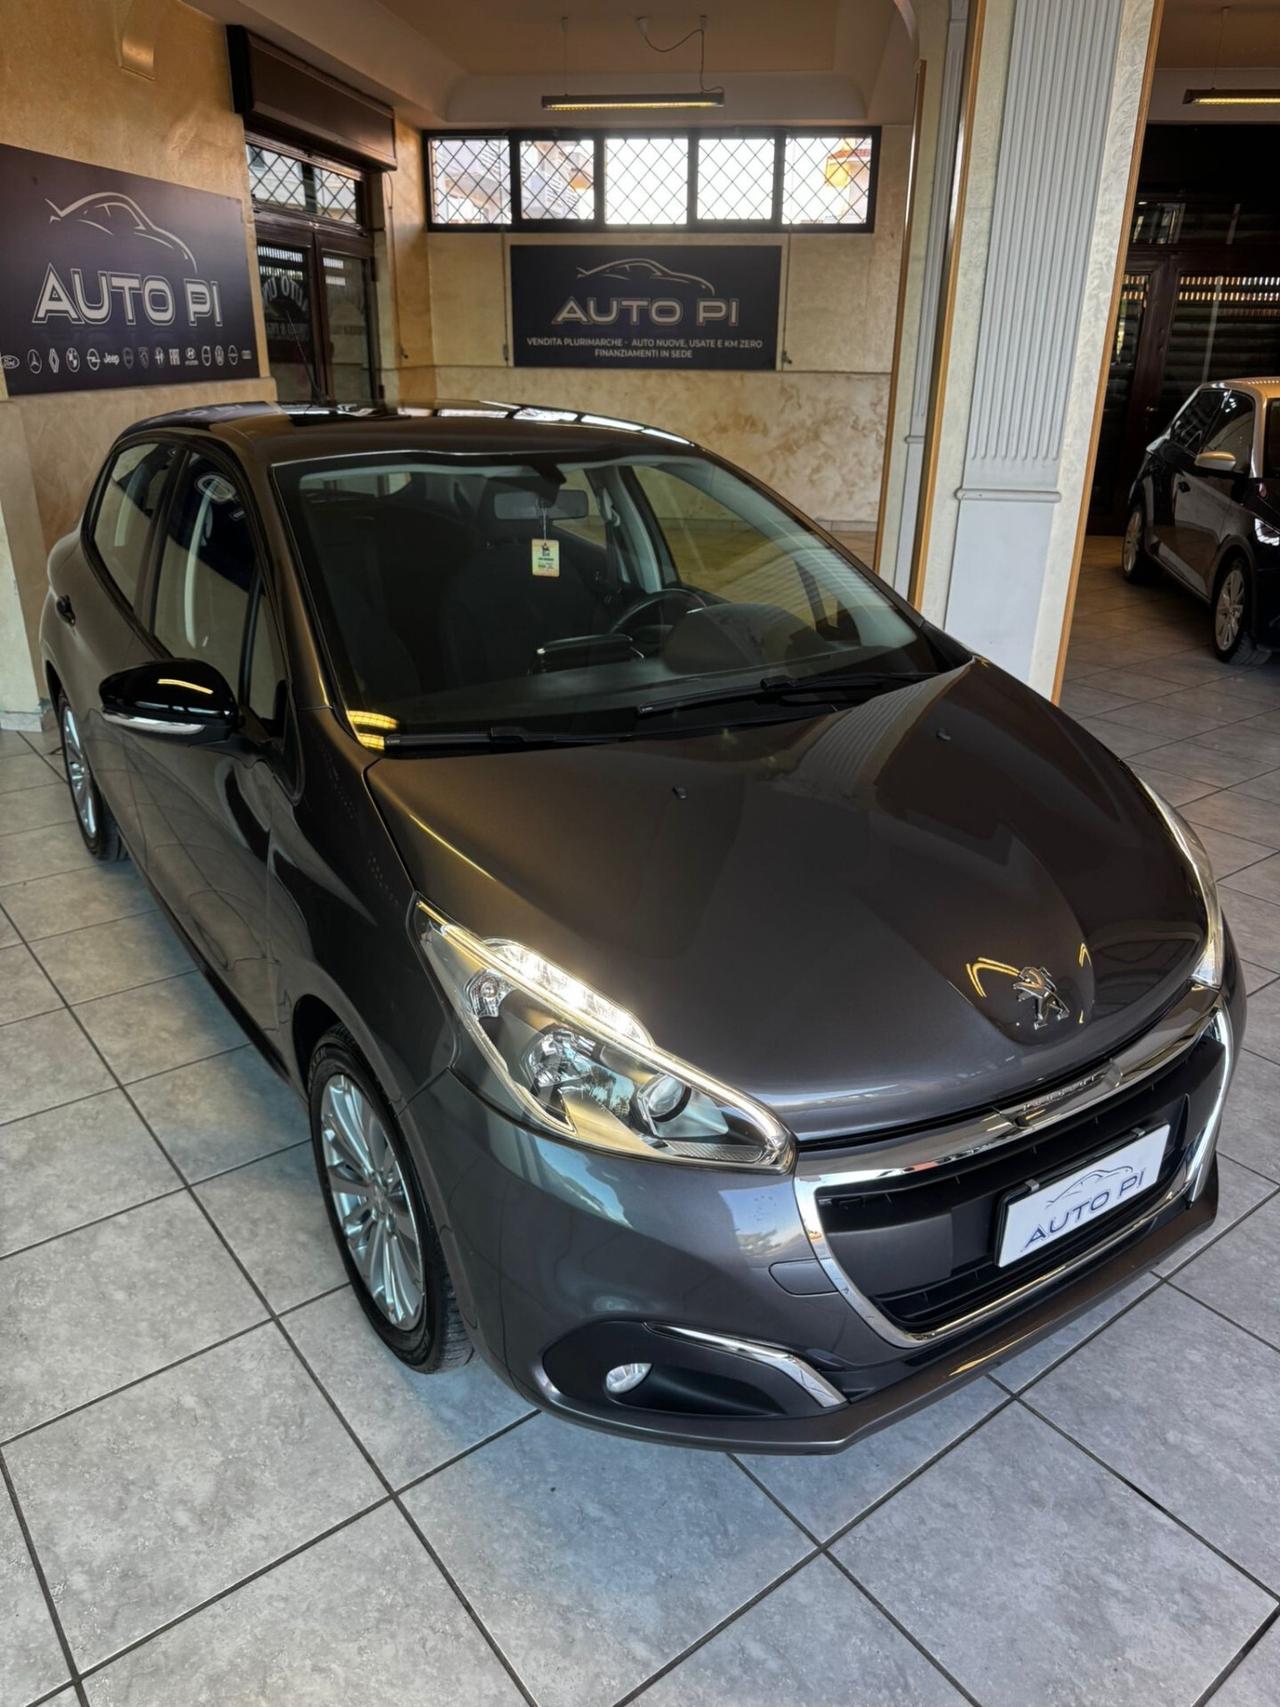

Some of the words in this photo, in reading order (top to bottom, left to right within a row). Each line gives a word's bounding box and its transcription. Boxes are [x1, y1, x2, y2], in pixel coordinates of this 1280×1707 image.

[32, 262, 176, 326] AUTO
[184, 278, 224, 327] PI
[551, 296, 683, 326] AUTO
[696, 298, 739, 327] PI
[526, 337, 562, 346] VENDITA
[563, 338, 623, 347] PLURIMARCHE
[631, 338, 656, 347] AUTO
[689, 339, 715, 348] USATE
[717, 339, 723, 348] E
[739, 340, 763, 349] ZERO
[594, 349, 659, 358] FINANZIAMENTI
[660, 350, 669, 358] IN
[671, 350, 693, 359] SEDE
[1022, 1191, 1110, 1250] AUTO
[1118, 1168, 1147, 1198] PI
